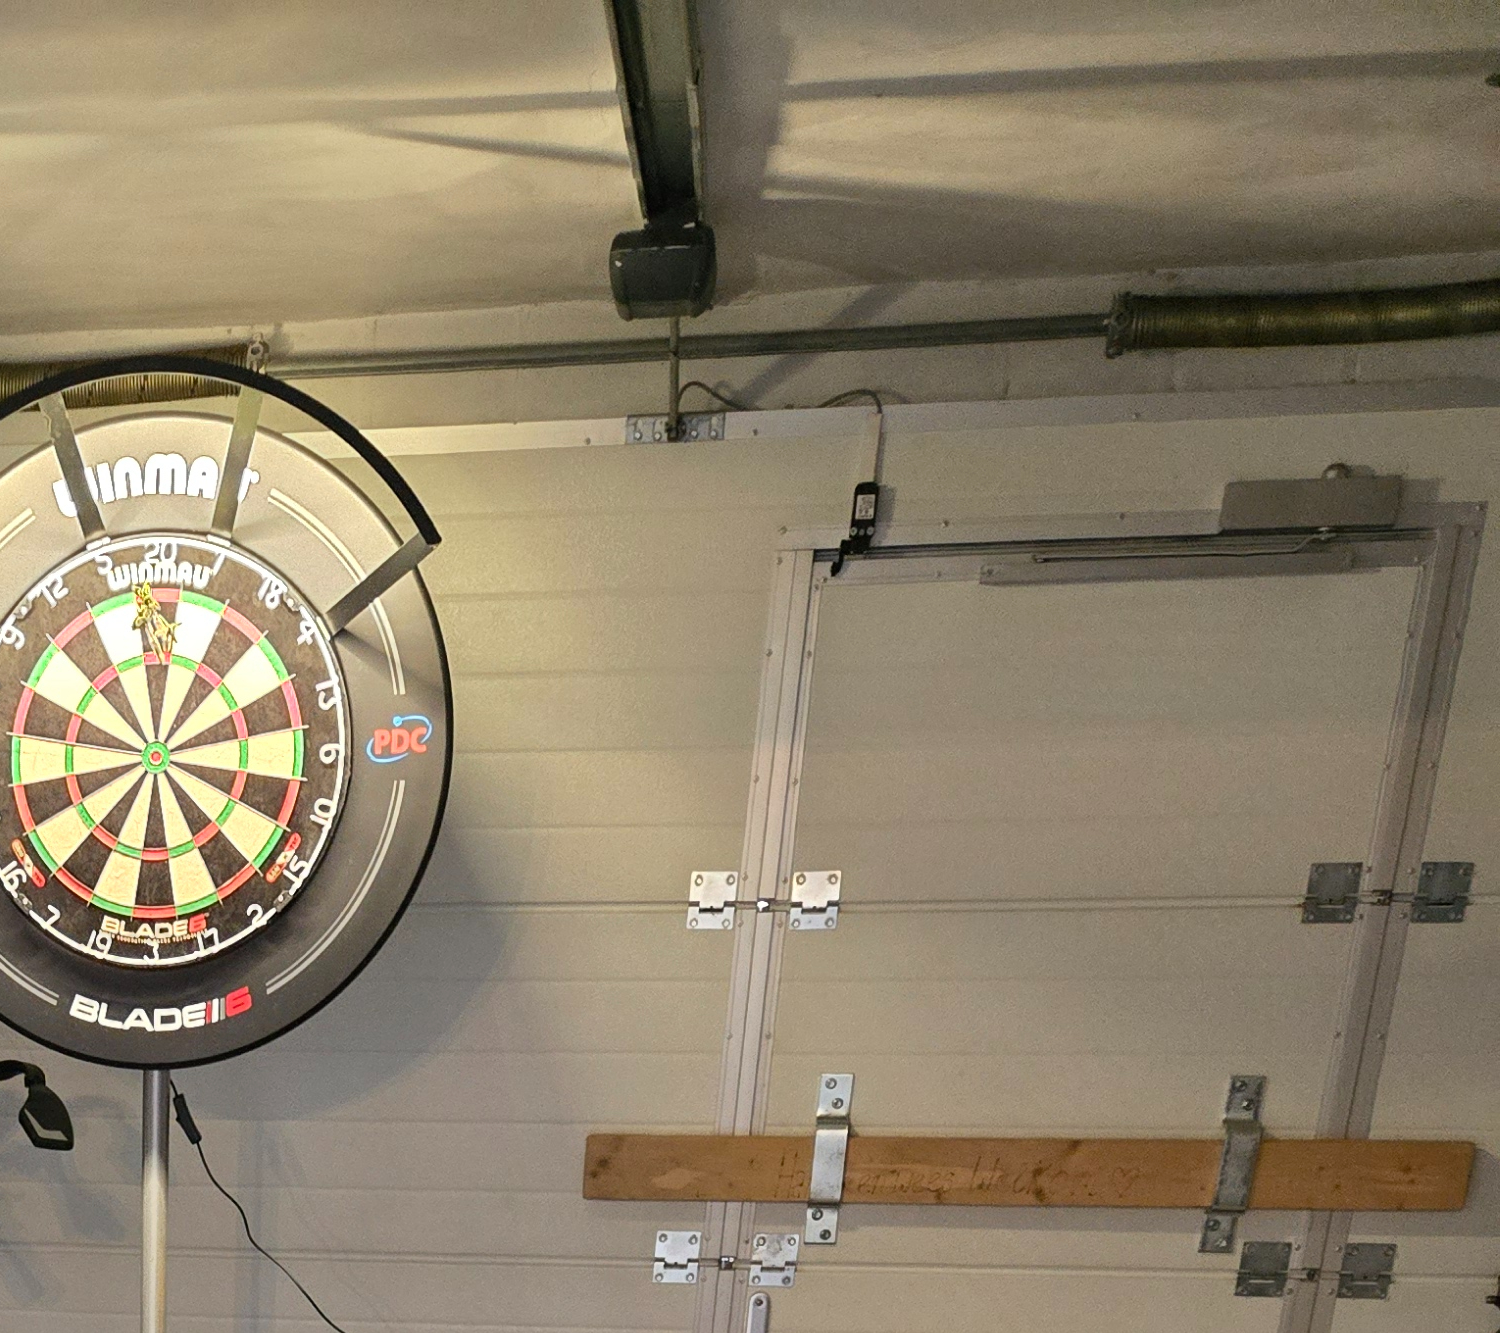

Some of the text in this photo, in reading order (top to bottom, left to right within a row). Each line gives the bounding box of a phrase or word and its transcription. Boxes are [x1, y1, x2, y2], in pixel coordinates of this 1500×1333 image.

[52, 452, 252, 518] WINMA
[94, 553, 113, 576] 5
[144, 543, 179, 564] 20
[107, 561, 211, 591] WINMAU
[38, 575, 69, 608] 12
[258, 576, 288, 609] 18
[1, 625, 26, 650] 9
[297, 620, 316, 646] 4
[315, 678, 340, 710] 13
[319, 743, 342, 764] 6
[374, 727, 427, 754] PDC
[310, 797, 335, 827] 10
[1, 861, 27, 890] 16
[283, 855, 309, 884] 15
[44, 904, 61, 929] 7
[246, 903, 266, 928] 2
[88, 930, 112, 958] 19
[197, 927, 219, 953] 17
